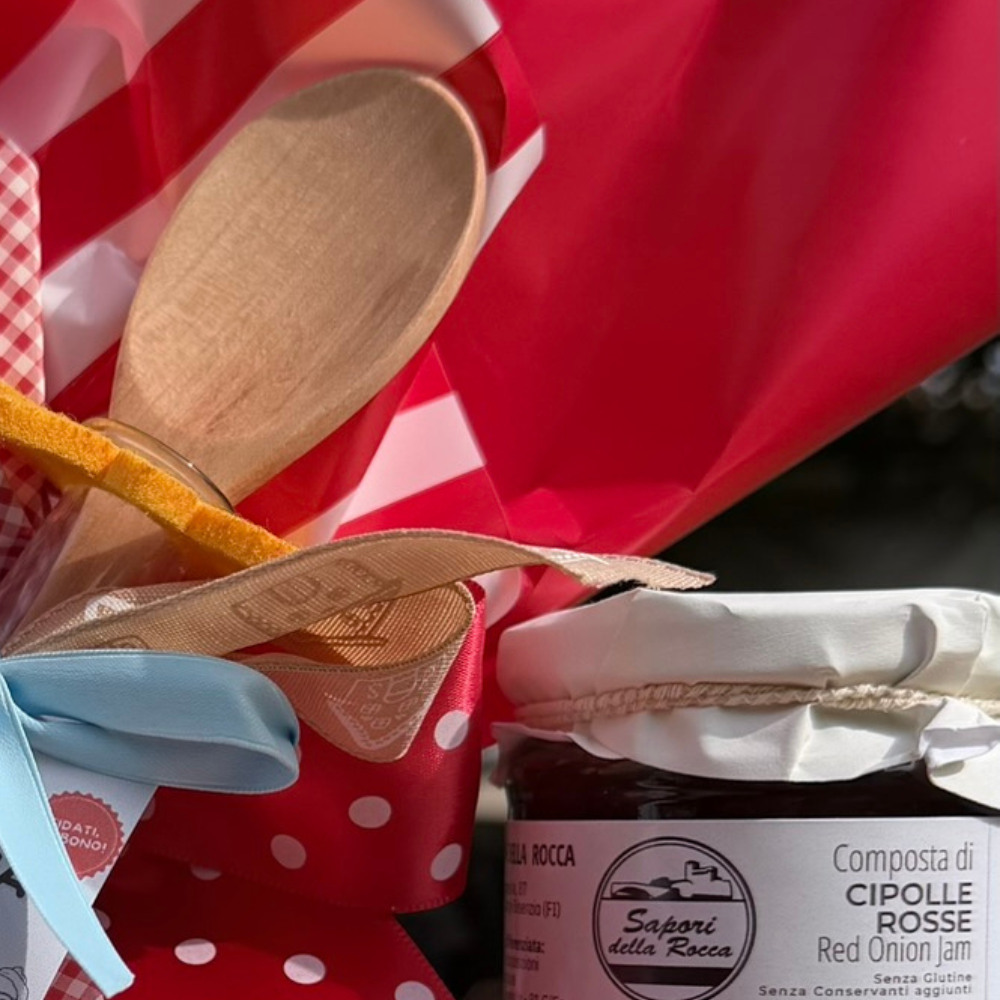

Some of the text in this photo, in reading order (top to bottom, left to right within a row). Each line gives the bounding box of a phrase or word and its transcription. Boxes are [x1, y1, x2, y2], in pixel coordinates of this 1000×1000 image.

[58, 819, 100, 838] IDATI,
[532, 843, 576, 867] ROCCA
[833, 841, 974, 881] Composta di
[846, 882, 973, 907] CIPOLLE
[623, 908, 718, 941] Sapori
[877, 910, 973, 934] ROSSE
[608, 936, 734, 959] della Rocca
[817, 934, 972, 968] Red Onion Jam
[873, 972, 973, 985] Senza Glutine
[758, 984, 973, 998] Senza Conservanti aggiunti
